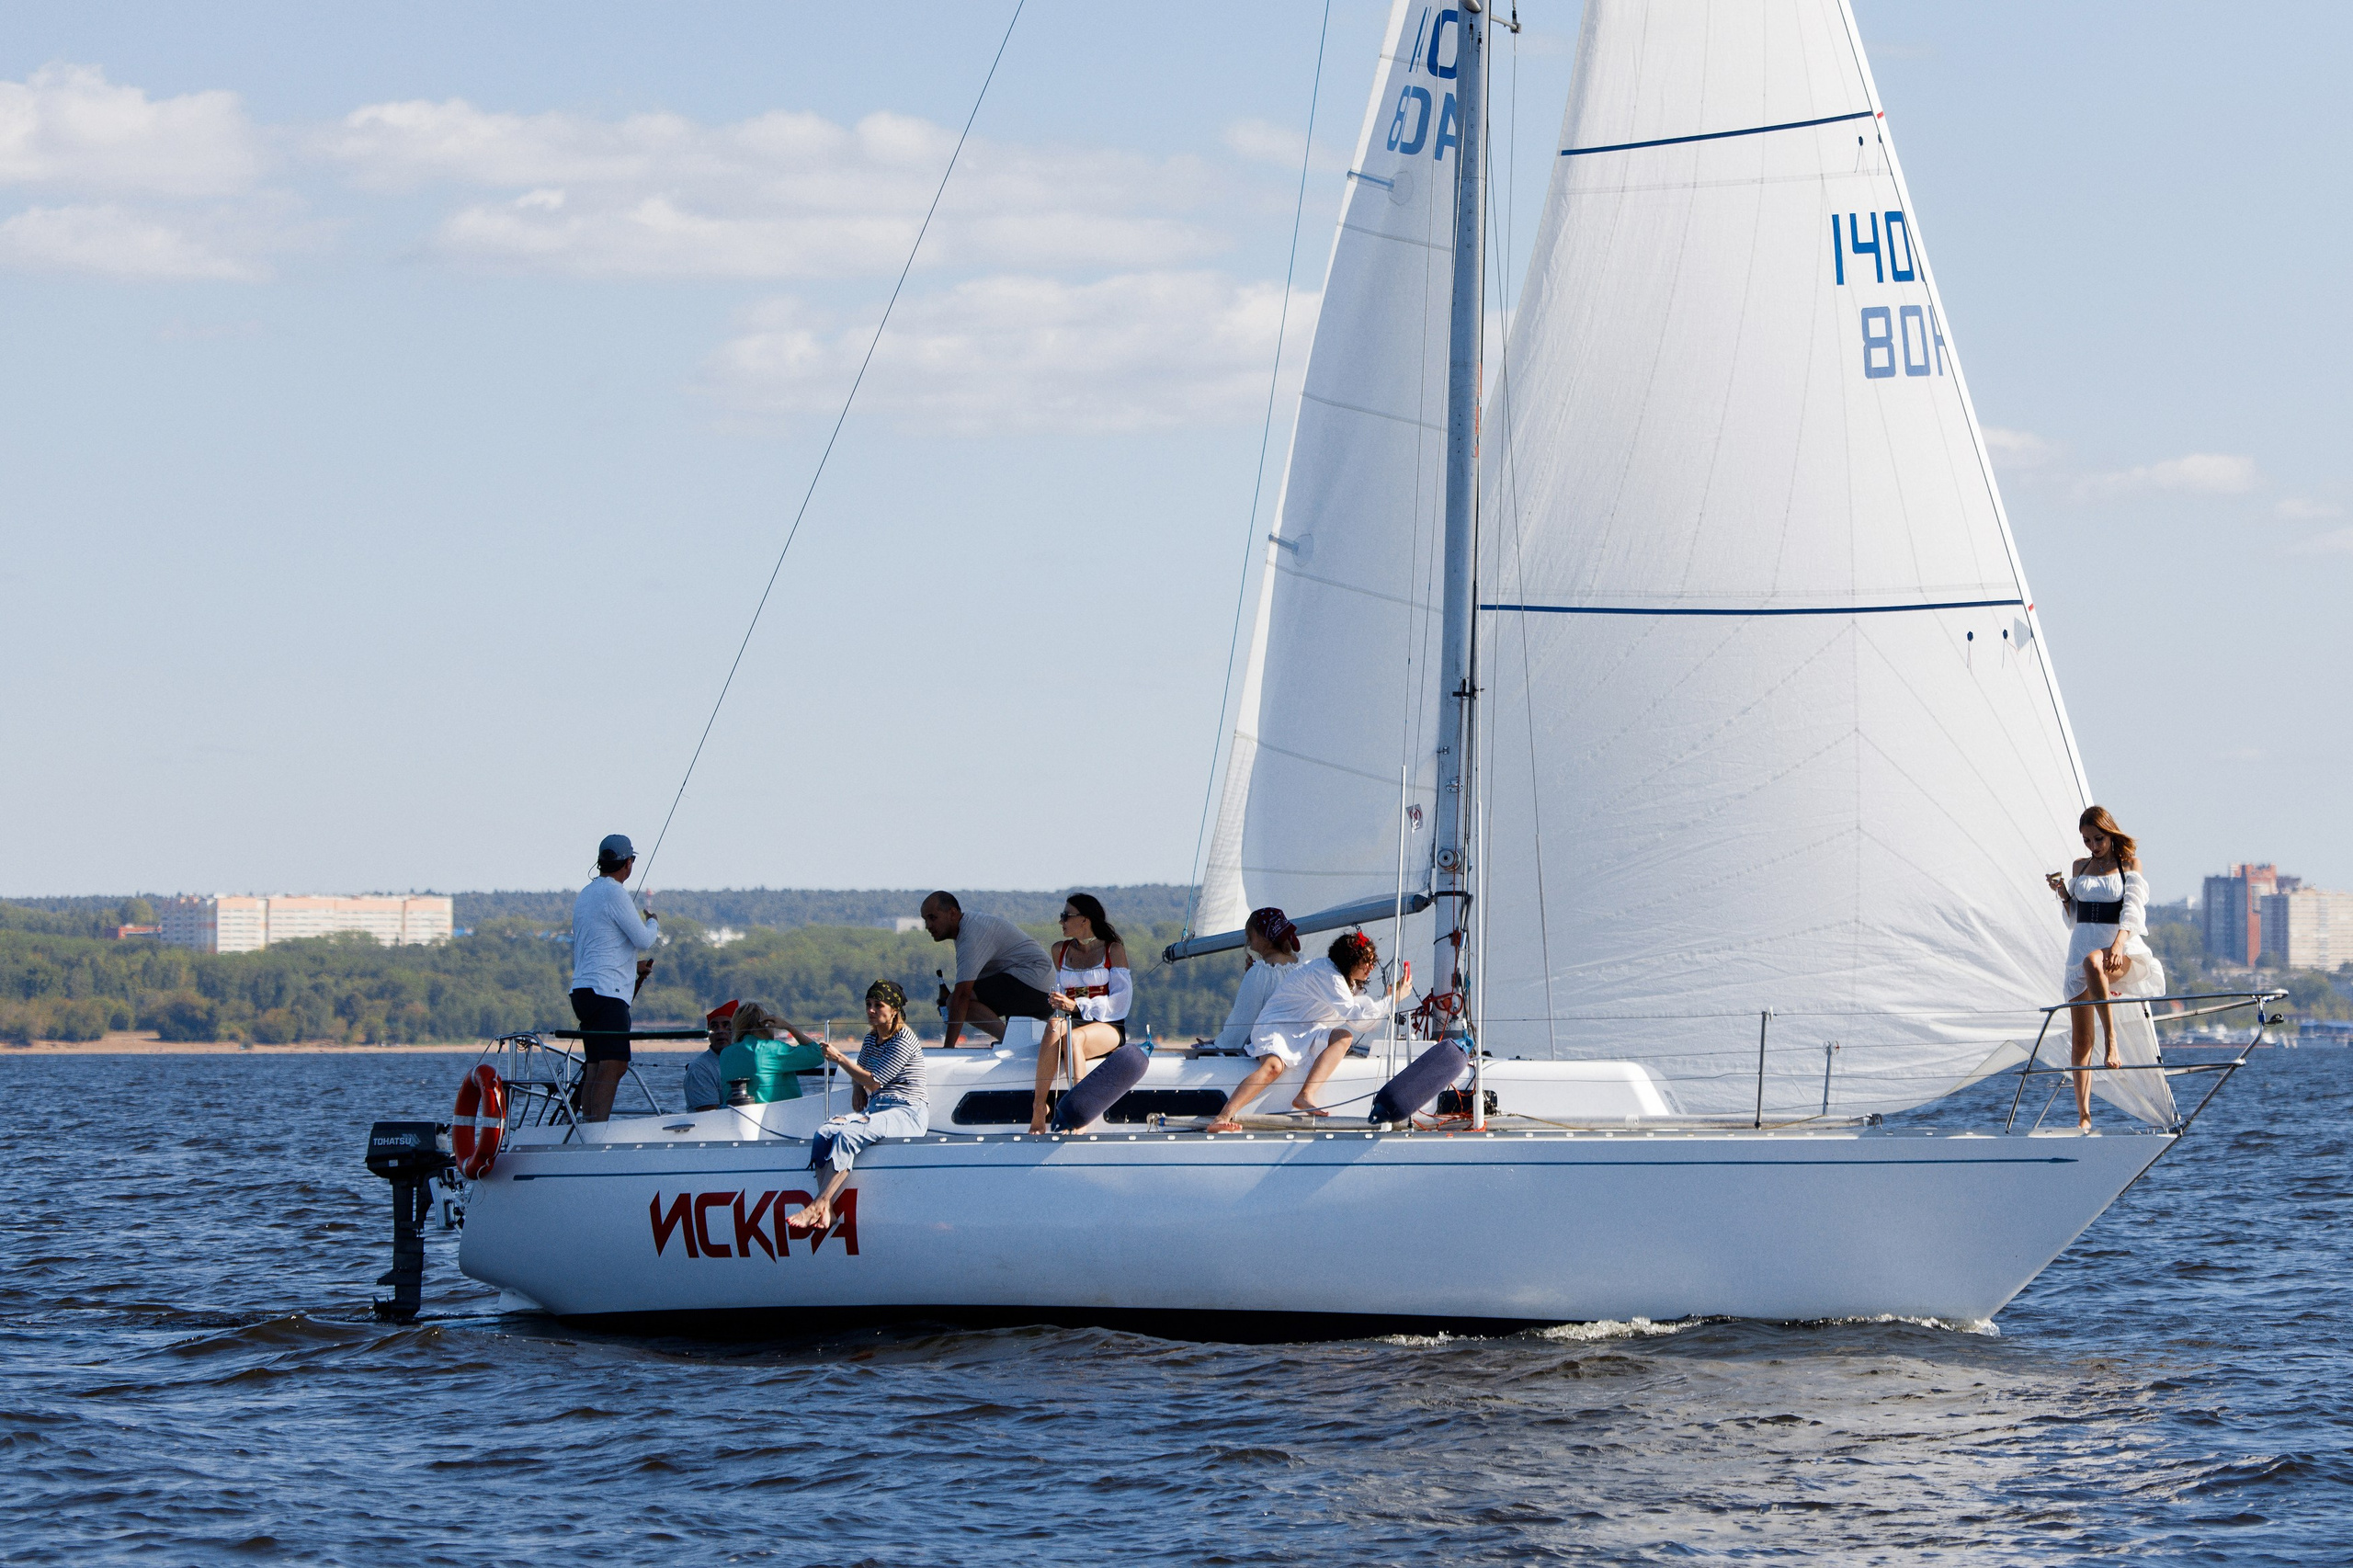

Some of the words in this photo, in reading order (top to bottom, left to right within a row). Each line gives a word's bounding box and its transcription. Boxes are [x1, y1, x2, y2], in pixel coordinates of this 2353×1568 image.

[1832, 210, 1926, 285] 140
[373, 1136, 412, 1146] TOHATSU
[649, 1187, 859, 1264] ИСКРА
